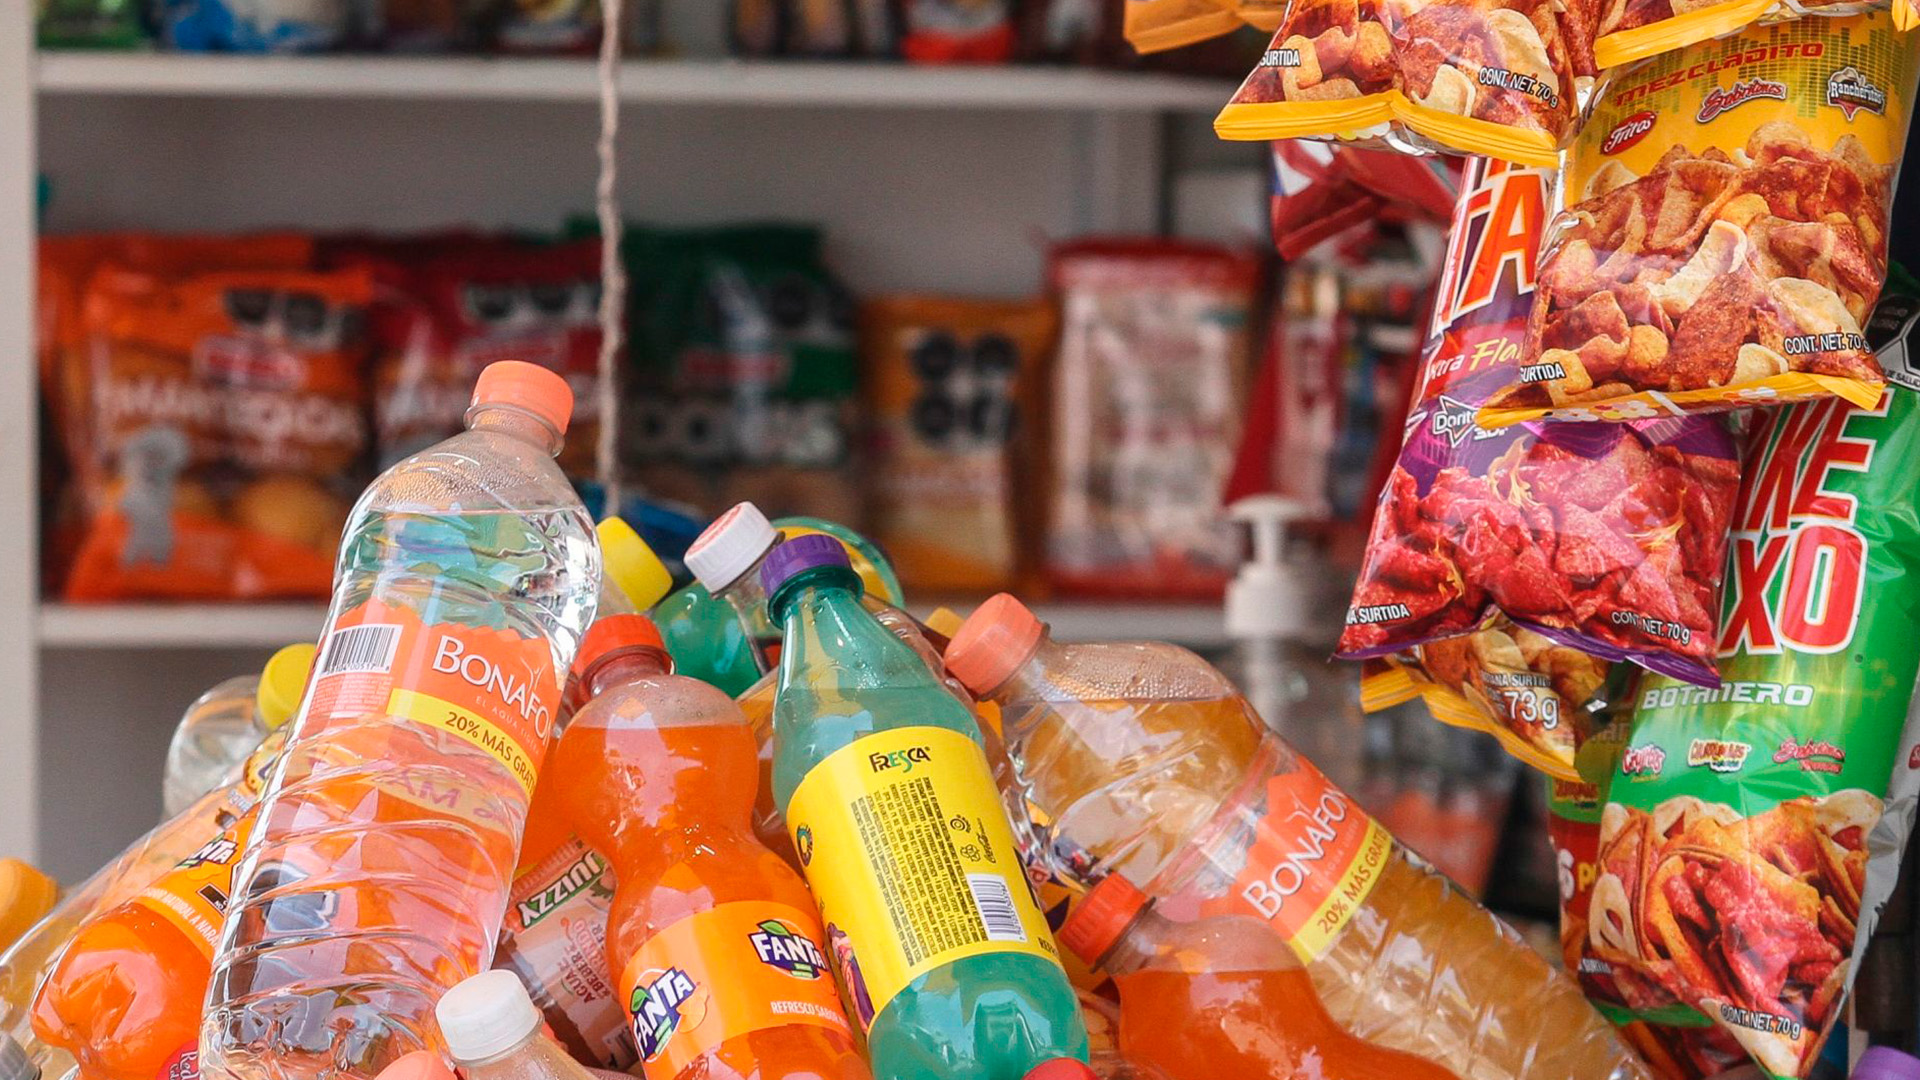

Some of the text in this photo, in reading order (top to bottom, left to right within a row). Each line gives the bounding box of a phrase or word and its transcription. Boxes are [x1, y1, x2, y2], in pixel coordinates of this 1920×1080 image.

[1479, 67, 1558, 108] CONT. NET. 70 g
[1616, 43, 1824, 107] MEZCLADITO
[1604, 114, 1655, 153] Fritos
[1469, 337, 1521, 371] Fla
[1784, 336, 1818, 355] CONT.
[1821, 334, 1845, 351] NET.
[1848, 334, 1862, 349] 70
[1359, 604, 1410, 624] SURTIDA
[1642, 619, 1665, 637] NET.
[1667, 623, 1681, 640] 70
[1681, 628, 1691, 645] g
[432, 635, 551, 747] BONAFO
[1504, 690, 1538, 722] 73
[1542, 698, 1558, 730] g
[1642, 681, 1815, 710] BOTANERO
[446, 711, 482, 738] 20%
[482, 731, 513, 761] MÁS
[868, 747, 930, 773] FRESCA
[1242, 787, 1348, 921] BONAFO
[518, 851, 602, 928] JUIZZY
[1317, 899, 1350, 934] 20%
[1343, 864, 1372, 902] MÁS
[195, 919, 220, 947] NARA
[751, 932, 826, 969] FANTA
[564, 972, 596, 1004] AGUA
[571, 951, 606, 994] BEBER
[633, 969, 694, 1053] FANTA
[770, 1001, 816, 1016] REFRESCO
[1721, 1004, 1800, 1040] CONT. NET. 70 g
